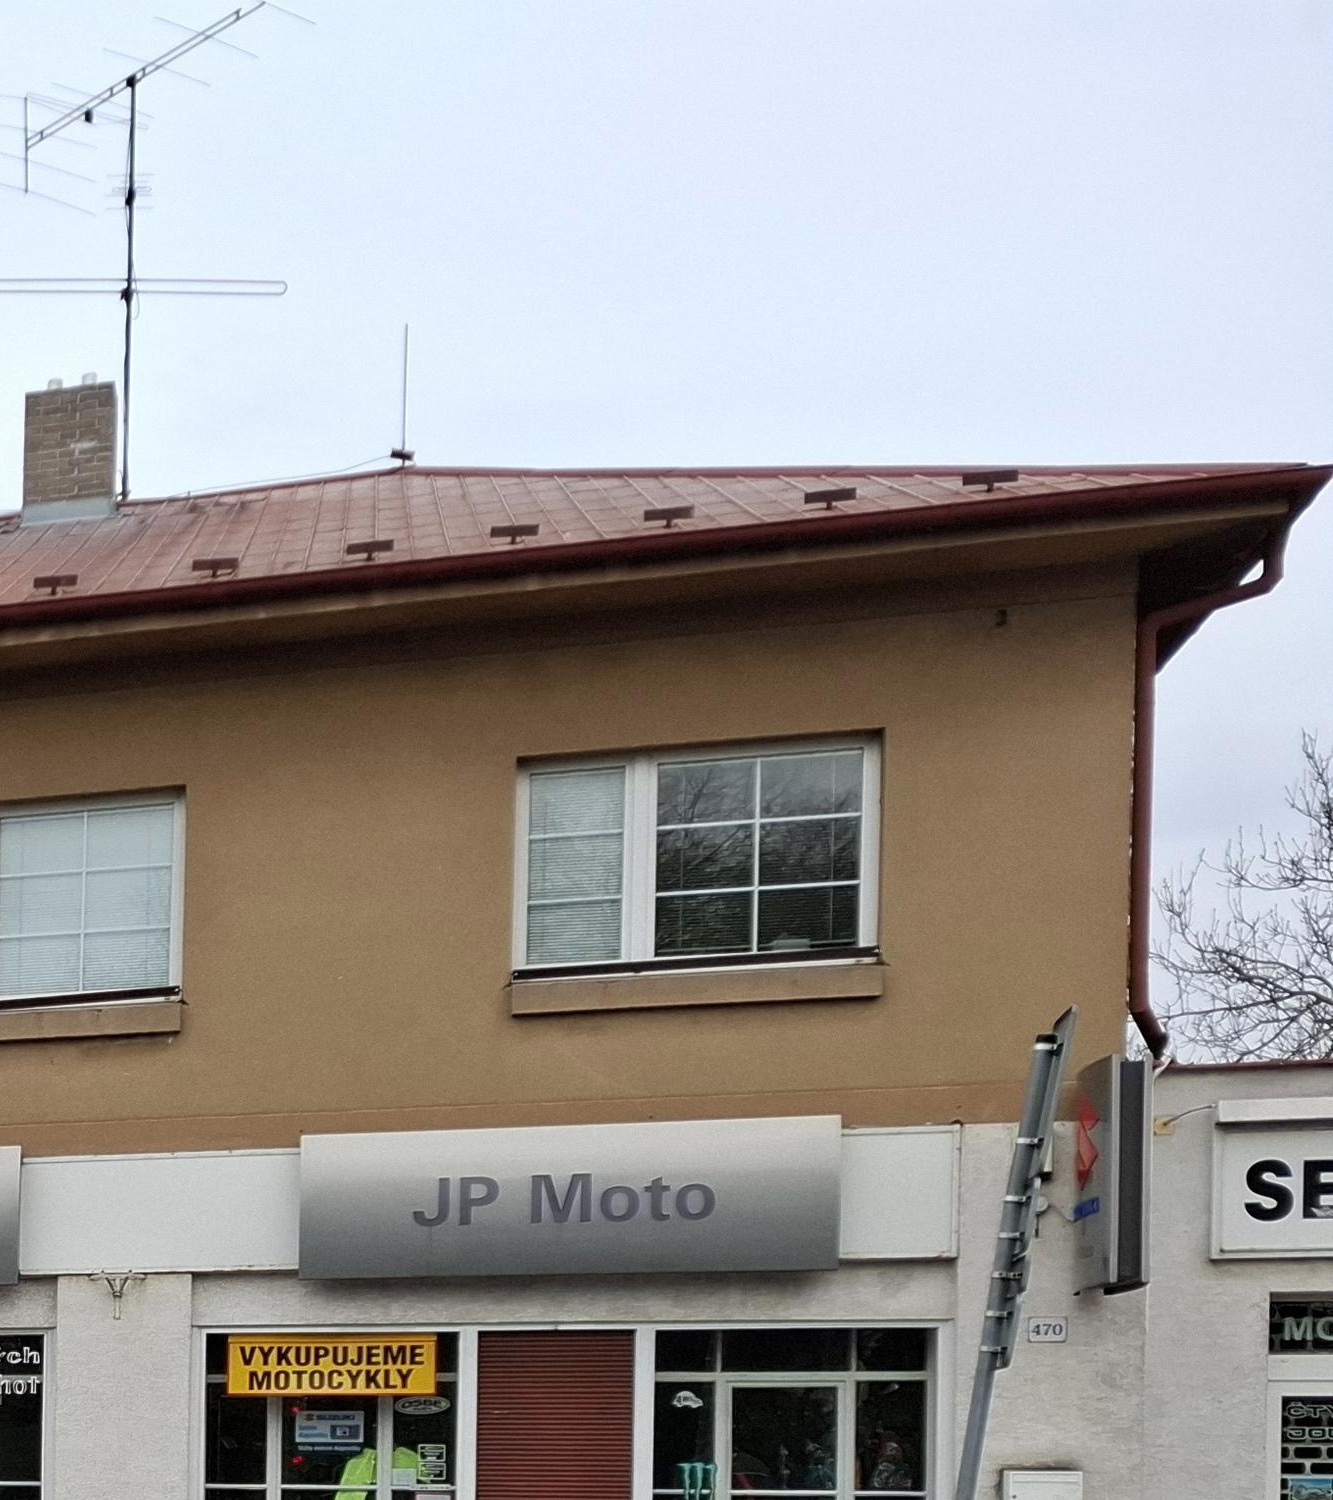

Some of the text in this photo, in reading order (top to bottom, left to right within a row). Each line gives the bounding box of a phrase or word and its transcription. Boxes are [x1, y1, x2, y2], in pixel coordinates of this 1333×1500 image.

[412, 1172, 717, 1227] JP Moto
[1031, 1323, 1064, 1337] 470
[238, 1344, 426, 1367] VYKUPUJEME
[247, 1368, 415, 1391] MOTOCYKLY
